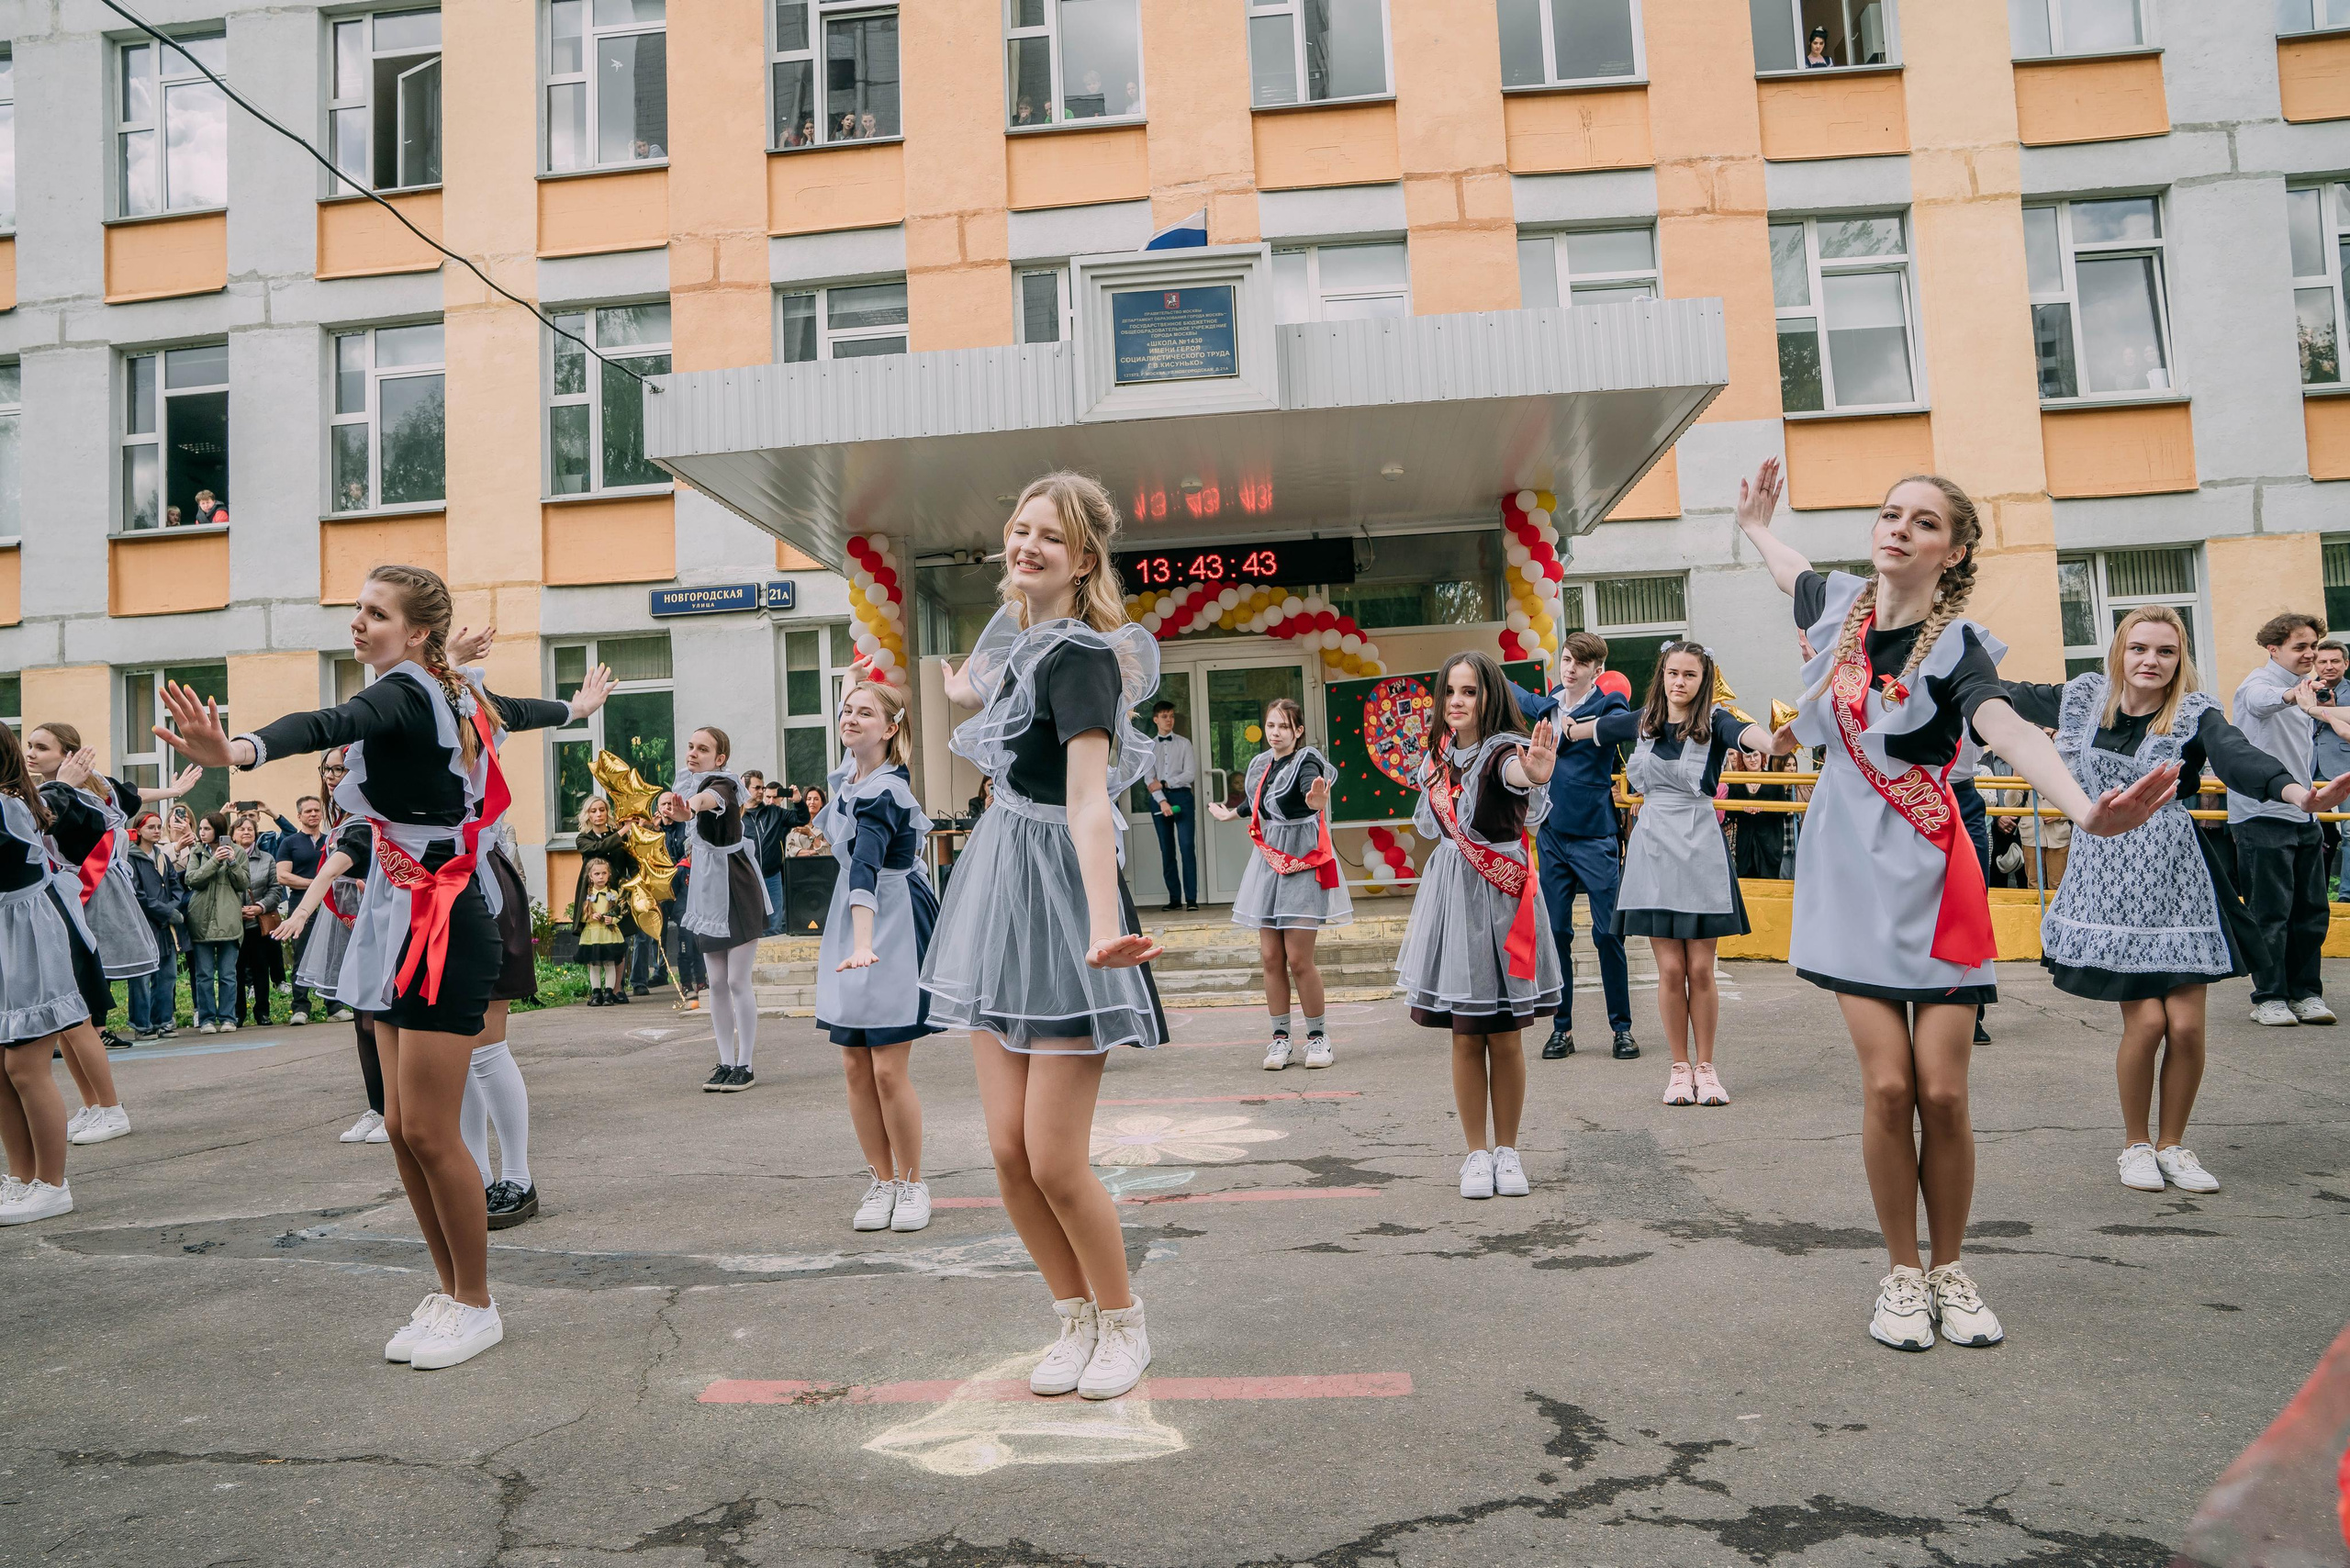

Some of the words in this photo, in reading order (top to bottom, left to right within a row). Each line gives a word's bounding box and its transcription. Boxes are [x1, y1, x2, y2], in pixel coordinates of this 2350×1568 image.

[1120, 326, 1190, 335] ОБЩЕОБРАЗОВАТЕЛЬНОЕ
[1120, 352, 1204, 364] СОЦИАЛИСТИЧЕСКОГО
[1207, 350, 1230, 358] ТРУДА
[1148, 346, 1175, 354] ИМЕНИ
[1136, 550, 1278, 584] 13:43:43
[664, 588, 744, 604] НОВГОРОДСКАЯ
[768, 588, 789, 601] 21А
[1888, 769, 1951, 831] 2022
[377, 841, 426, 884] 2022
[1484, 857, 1528, 891] 2022
